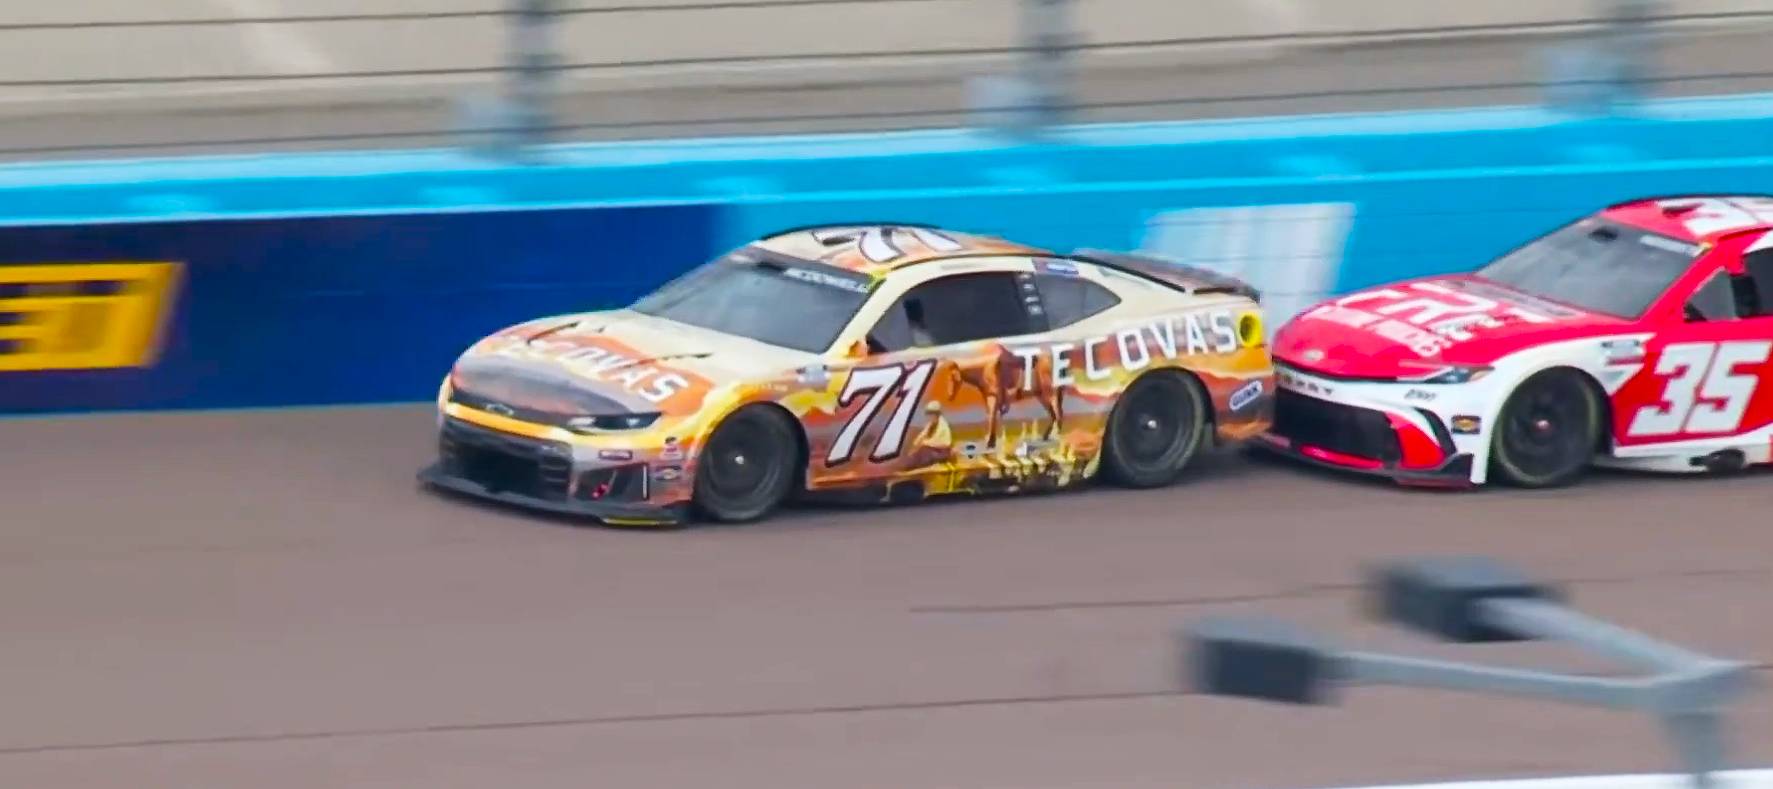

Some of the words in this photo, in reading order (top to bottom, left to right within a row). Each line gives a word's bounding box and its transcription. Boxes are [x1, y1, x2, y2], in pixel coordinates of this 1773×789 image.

[486, 336, 691, 404] ECOVAS
[1013, 311, 1238, 391] TECOVAS
[1626, 340, 1773, 437] 35
[825, 359, 937, 468] 71
